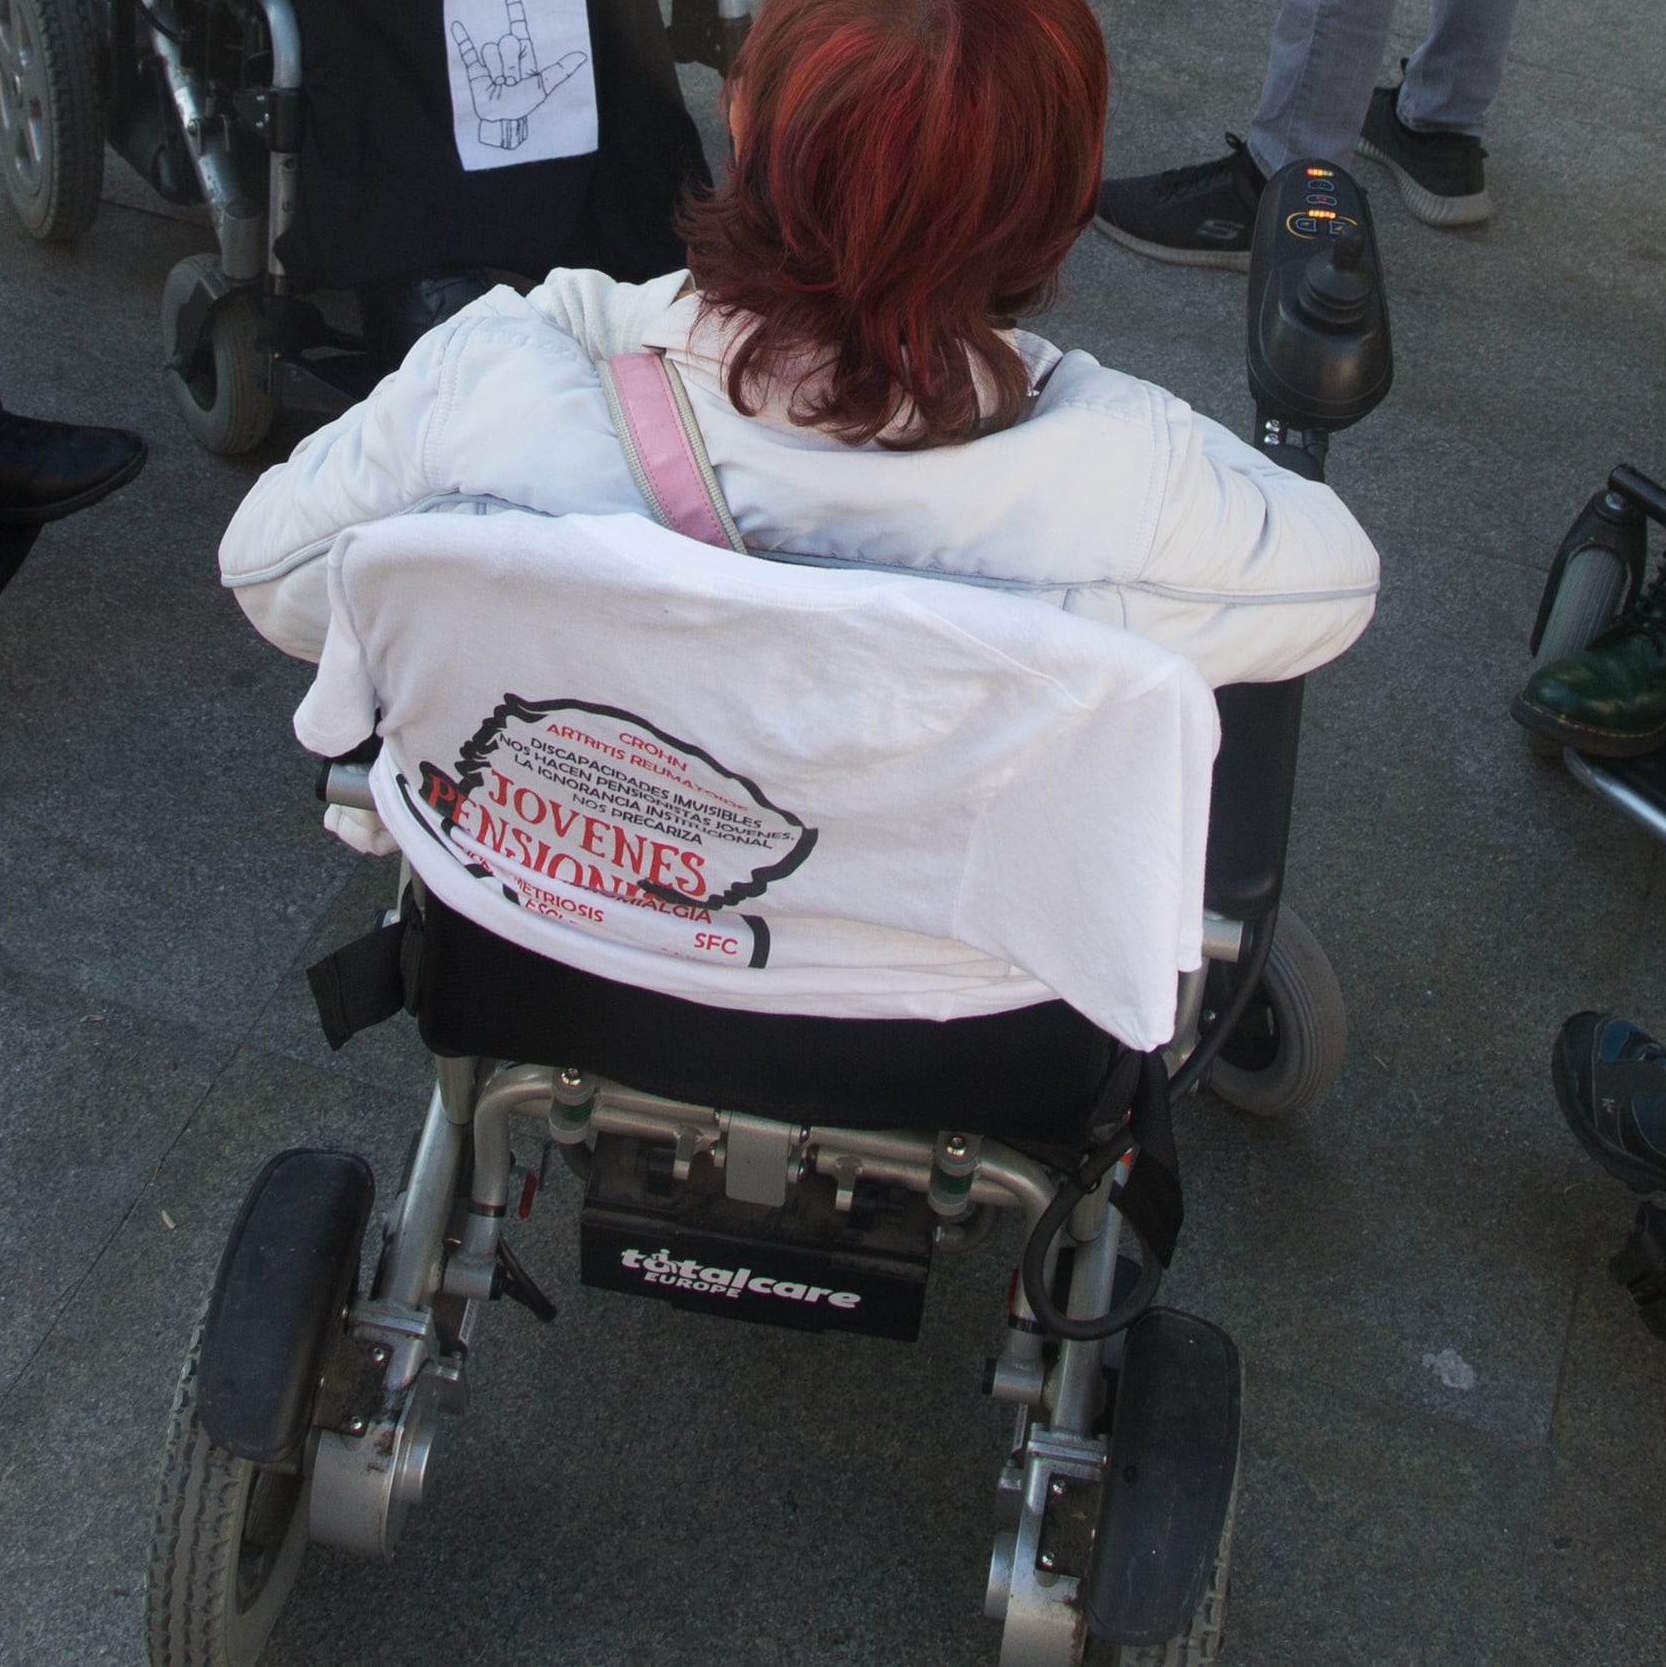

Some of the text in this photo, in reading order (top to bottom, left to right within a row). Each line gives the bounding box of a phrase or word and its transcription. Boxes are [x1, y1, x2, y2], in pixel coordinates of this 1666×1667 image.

[530, 737, 670, 800] DISCAPACIDADES
[546, 723, 626, 761] ARTRITIS
[618, 732, 688, 772] CROHN
[498, 732, 531, 757] NOS
[534, 752, 592, 783] HACEN
[595, 775, 712, 827] PENSIONISTAS
[514, 754, 774, 850] LA IGNORANCIA INSTITUCIONAL
[488, 769, 706, 896] JOVENES
[572, 792, 703, 846] NOS PRECARIZA
[694, 932, 739, 956] SFC
[620, 1248, 862, 1309] totalcare
[643, 1271, 743, 1299] EUROPE
